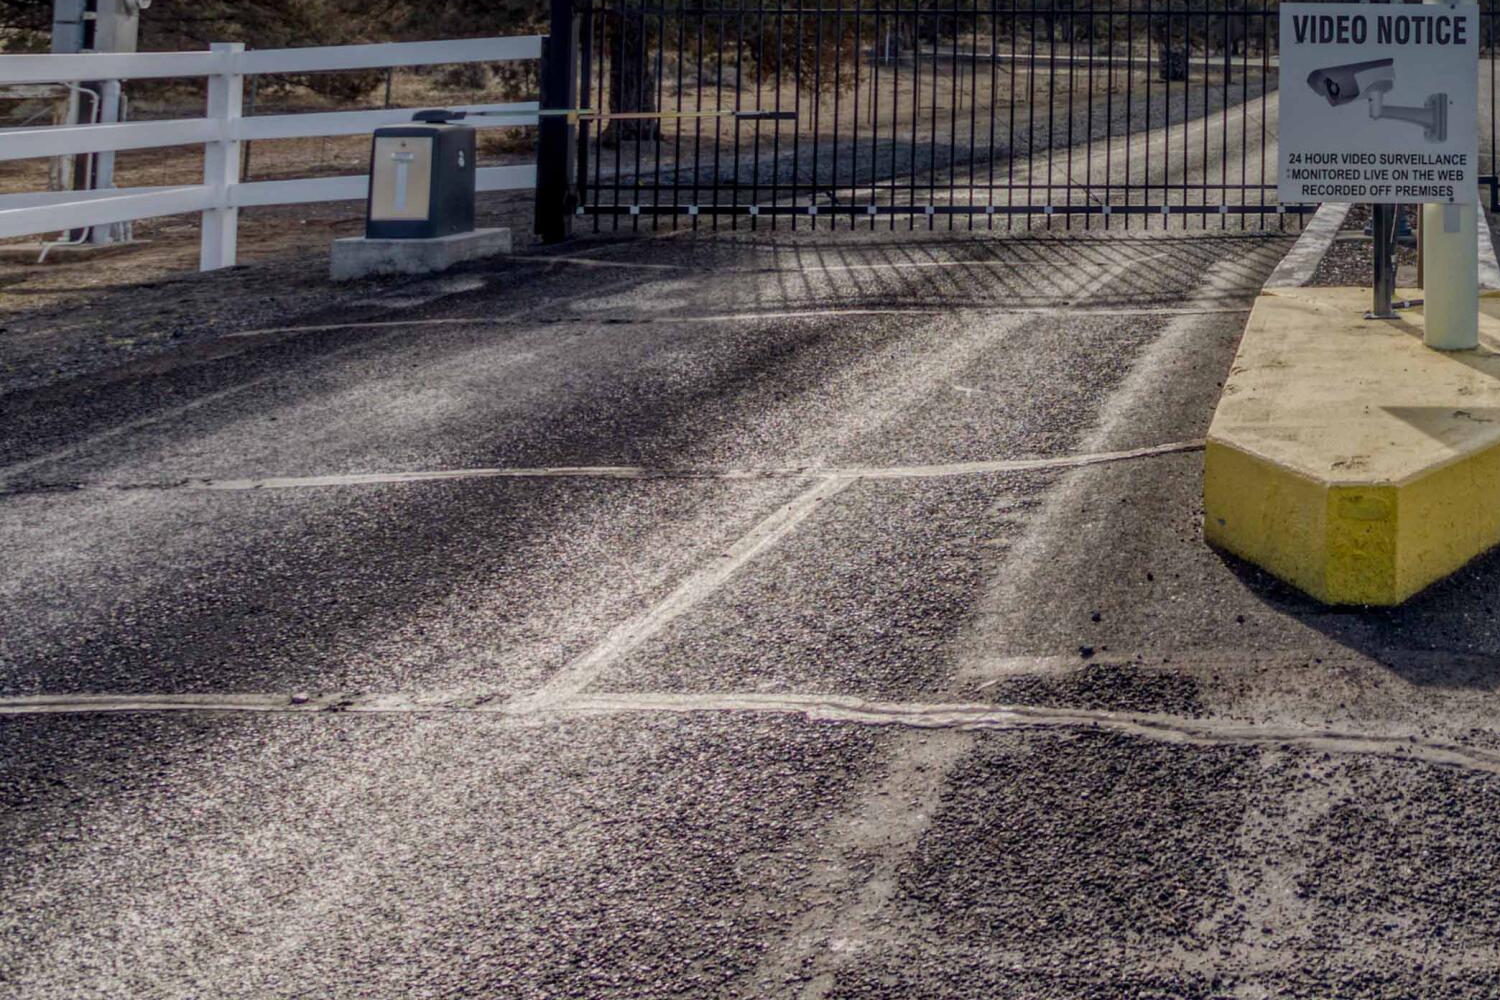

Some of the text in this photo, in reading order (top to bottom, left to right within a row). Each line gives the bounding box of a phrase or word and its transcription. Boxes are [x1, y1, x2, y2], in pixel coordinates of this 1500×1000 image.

[1293, 15, 1467, 45] VIDEO NOTICE
[1288, 153, 1467, 166] 24 HOUR VIDEO SURVEILLANCE
[1292, 168, 1464, 181] MONITORED LIVE ON THE WEB
[1302, 184, 1454, 197] RECORDED OFF PREMISES
